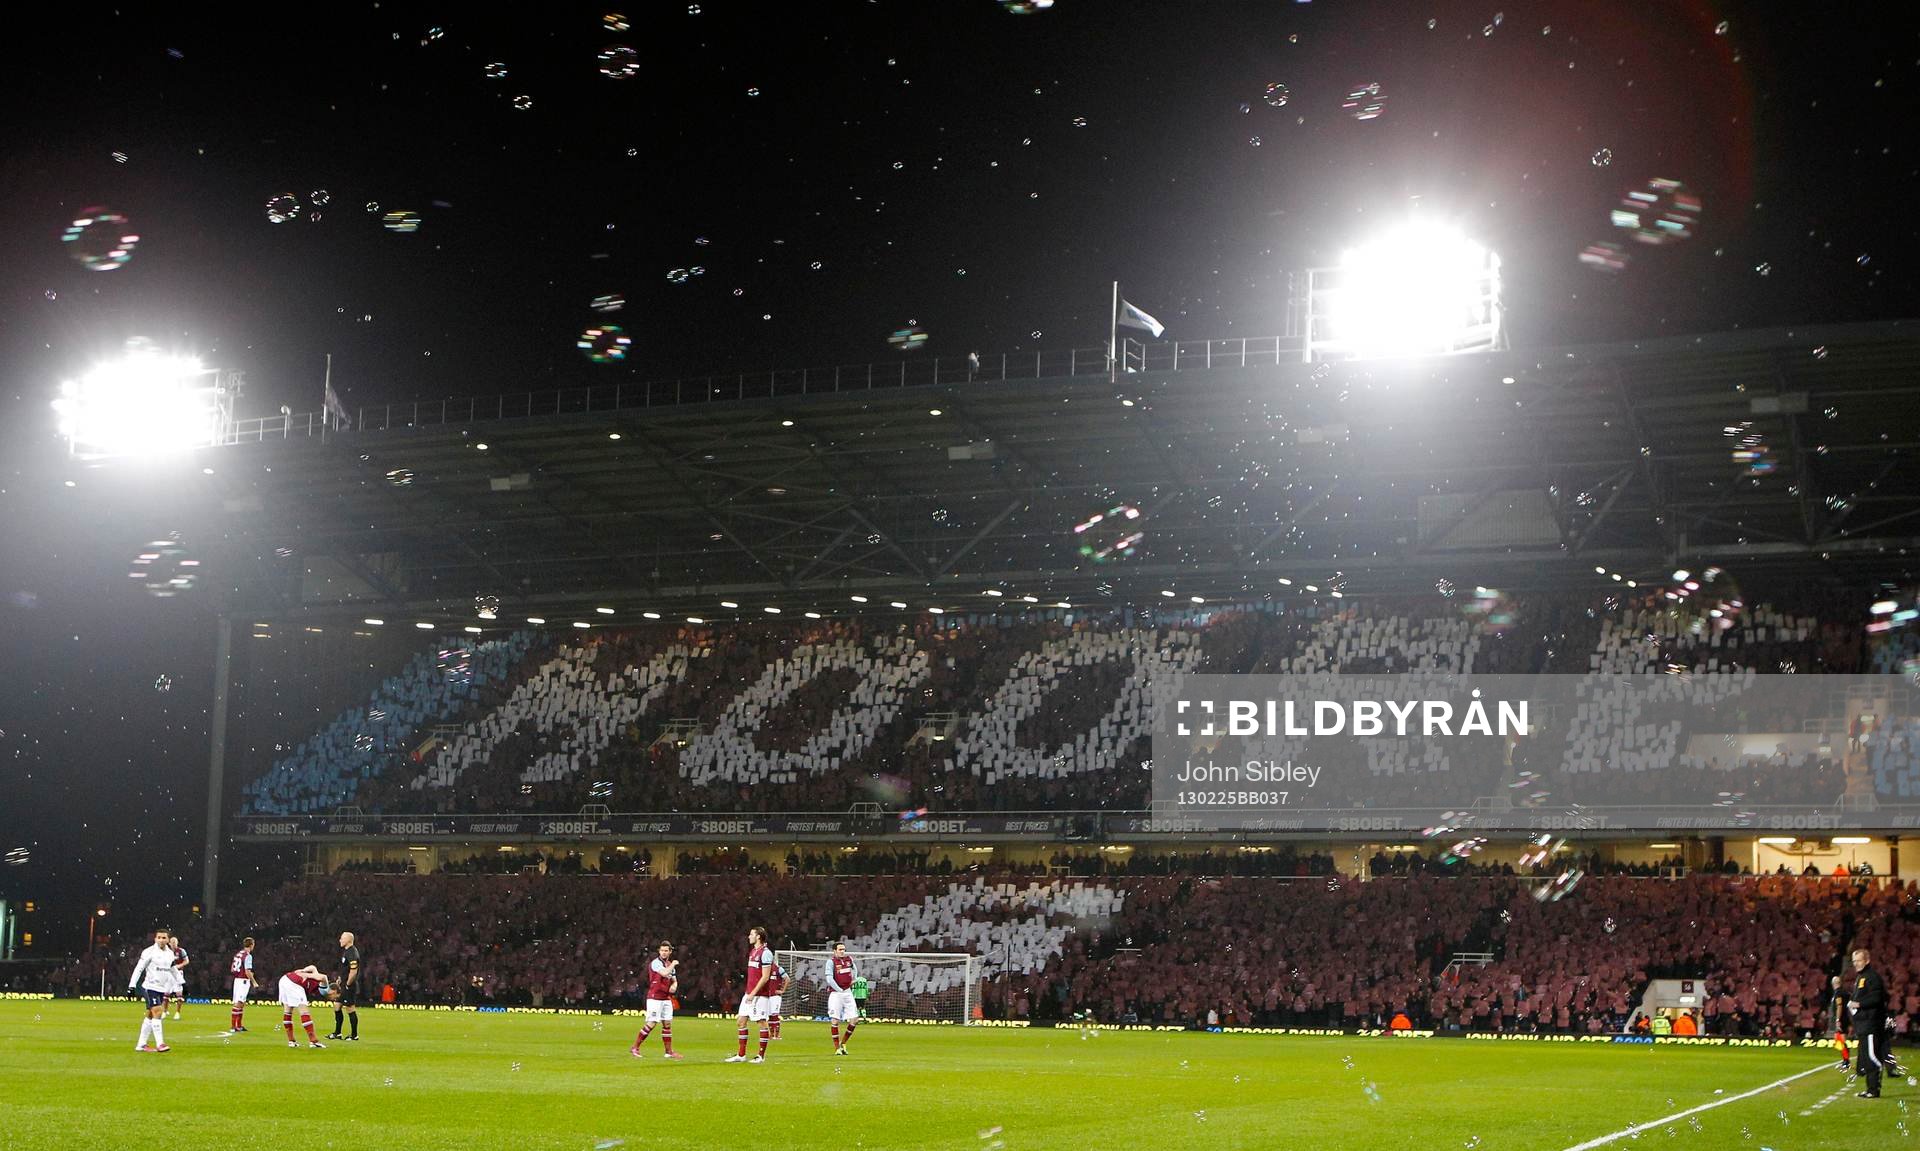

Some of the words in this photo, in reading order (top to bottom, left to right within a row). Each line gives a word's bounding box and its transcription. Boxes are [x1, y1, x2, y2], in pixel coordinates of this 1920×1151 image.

[786, 822, 814, 832] FASTEST
[815, 822, 841, 831] PAYOUT
[1005, 821, 1024, 831] BEST
[1025, 821, 1049, 831] PRICES
